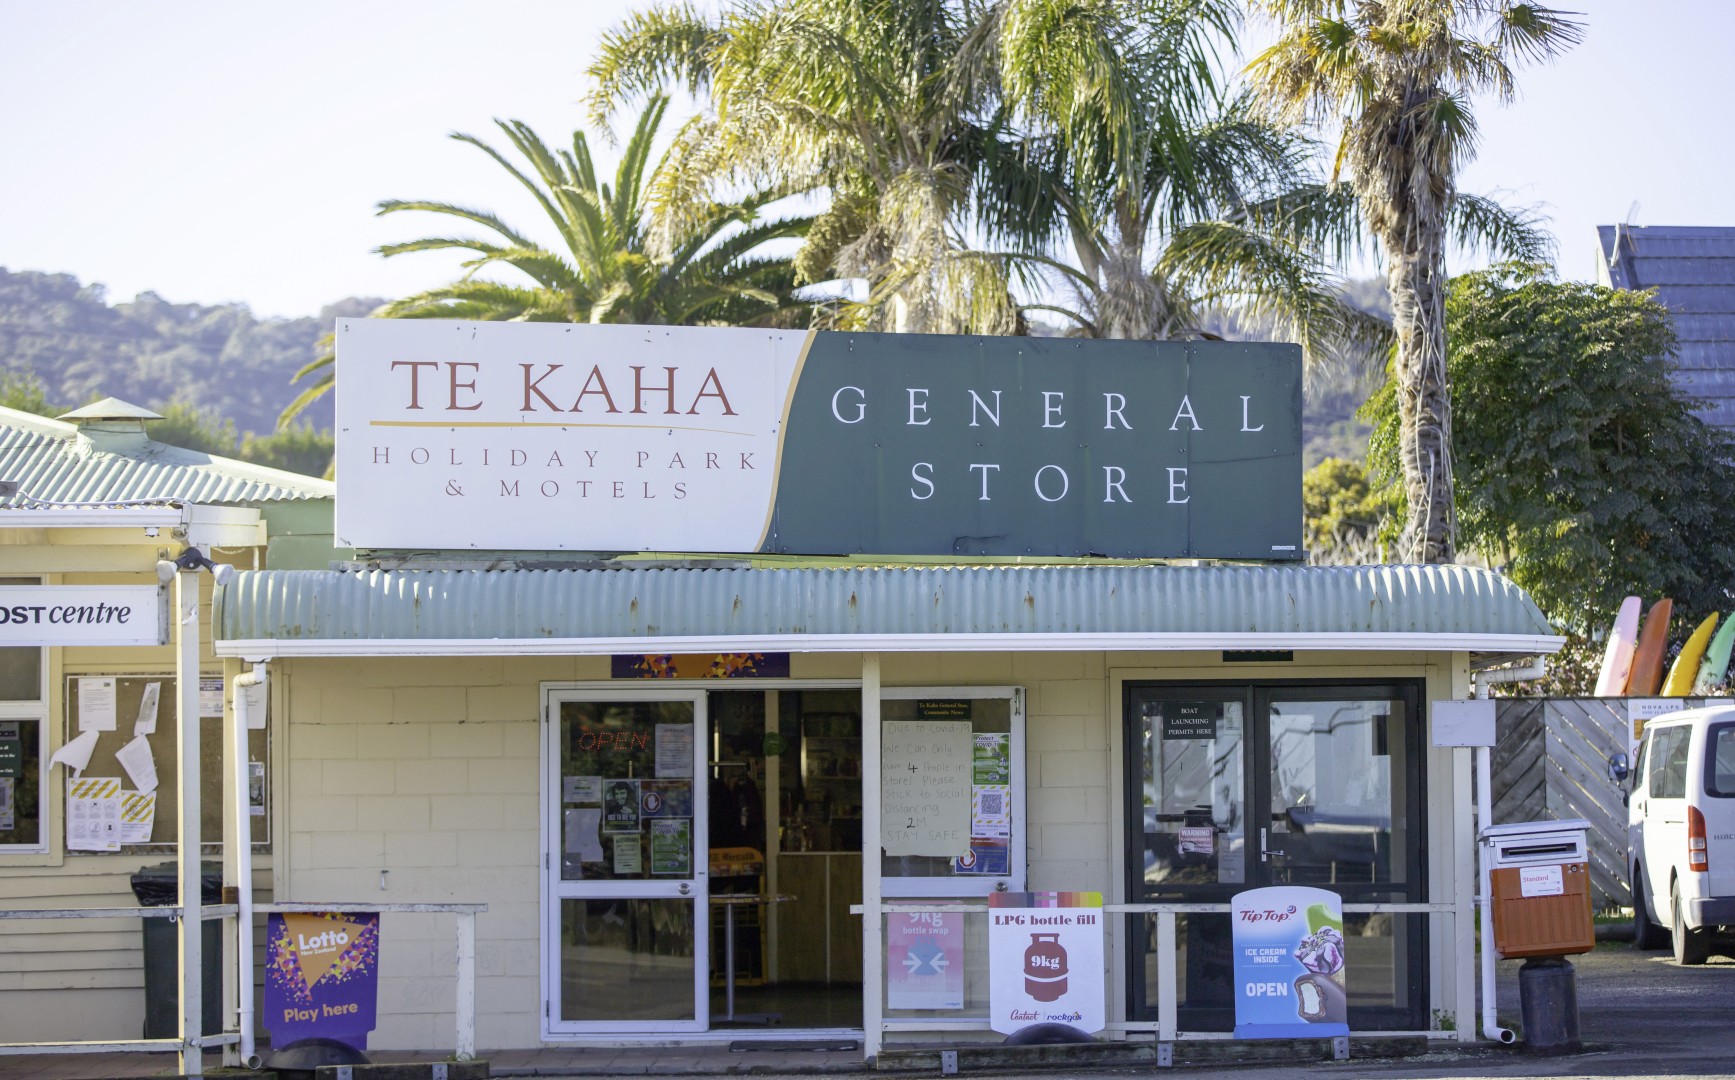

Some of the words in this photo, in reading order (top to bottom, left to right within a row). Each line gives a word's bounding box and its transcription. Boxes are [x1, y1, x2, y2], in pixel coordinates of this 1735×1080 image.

[391, 360, 484, 411] TE
[518, 363, 739, 416] KAHA
[831, 386, 1264, 432] GENERAL
[372, 446, 599, 468] HOLIDAY
[637, 451, 756, 470] PARK
[445, 479, 465, 497] &
[499, 480, 688, 499] MOTELS
[910, 462, 1191, 504] STORE
[48, 602, 131, 624] centre
[888, 722, 910, 734] Due
[916, 724, 925, 733] to
[578, 731, 648, 750] OPEN
[907, 762, 919, 774] 4
[928, 830, 959, 841] SAFE
[1181, 829, 1210, 837] WARNING
[1522, 875, 1549, 883] Standard
[994, 914, 1025, 926] LPG
[1030, 914, 1072, 926] bottle
[1076, 914, 1096, 925] fill
[1239, 909, 1262, 923] Tip
[1263, 910, 1289, 923] Top
[902, 926, 927, 935] bottle
[928, 927, 949, 936] swap
[298, 930, 349, 951] Lotto
[1245, 948, 1257, 956] ICE
[1259, 948, 1287, 956] CREAM
[1253, 955, 1279, 963] INSIDE
[1031, 955, 1060, 970] 9kg
[1245, 982, 1288, 997] OPEN
[283, 1007, 319, 1022] Play
[322, 1003, 358, 1017] here
[1010, 1009, 1041, 1022] Contact
[1046, 1011, 1082, 1022] rockgas
